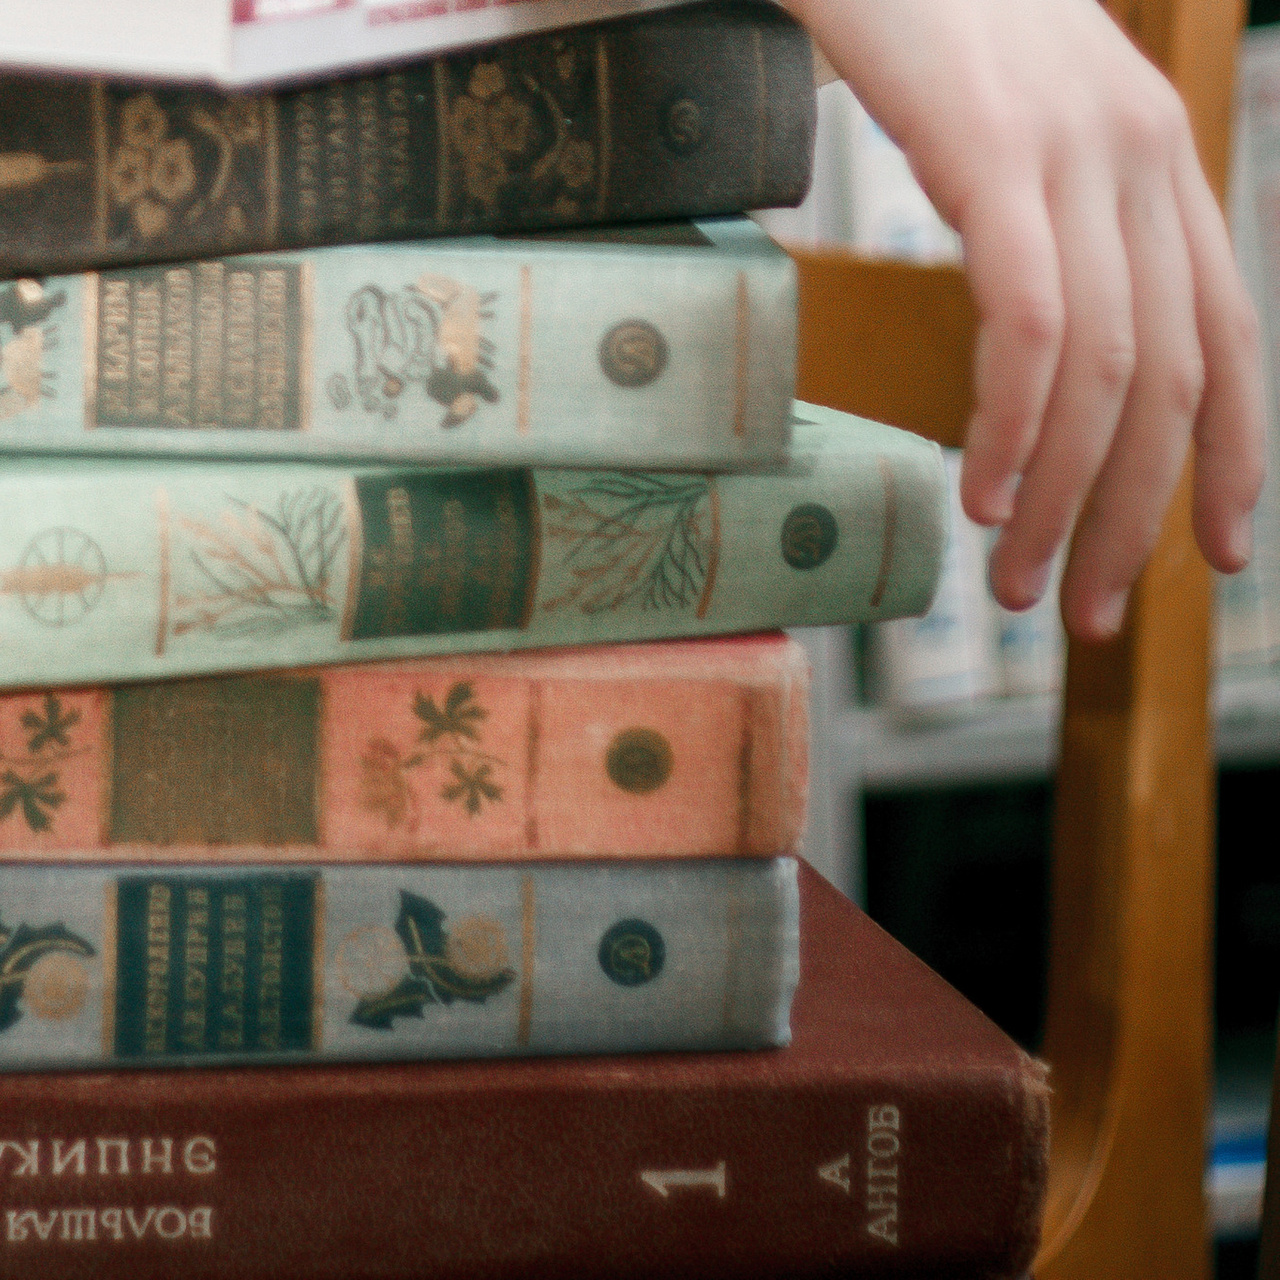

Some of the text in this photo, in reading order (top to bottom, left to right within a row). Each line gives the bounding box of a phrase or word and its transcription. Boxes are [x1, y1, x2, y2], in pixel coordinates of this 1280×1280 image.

[640, 1160, 727, 1200] 1
[818, 1153, 851, 1197] А
[866, 1103, 901, 1248] АНГОБ
[5, 1205, 214, 1242] БОЛЬШАЯ
